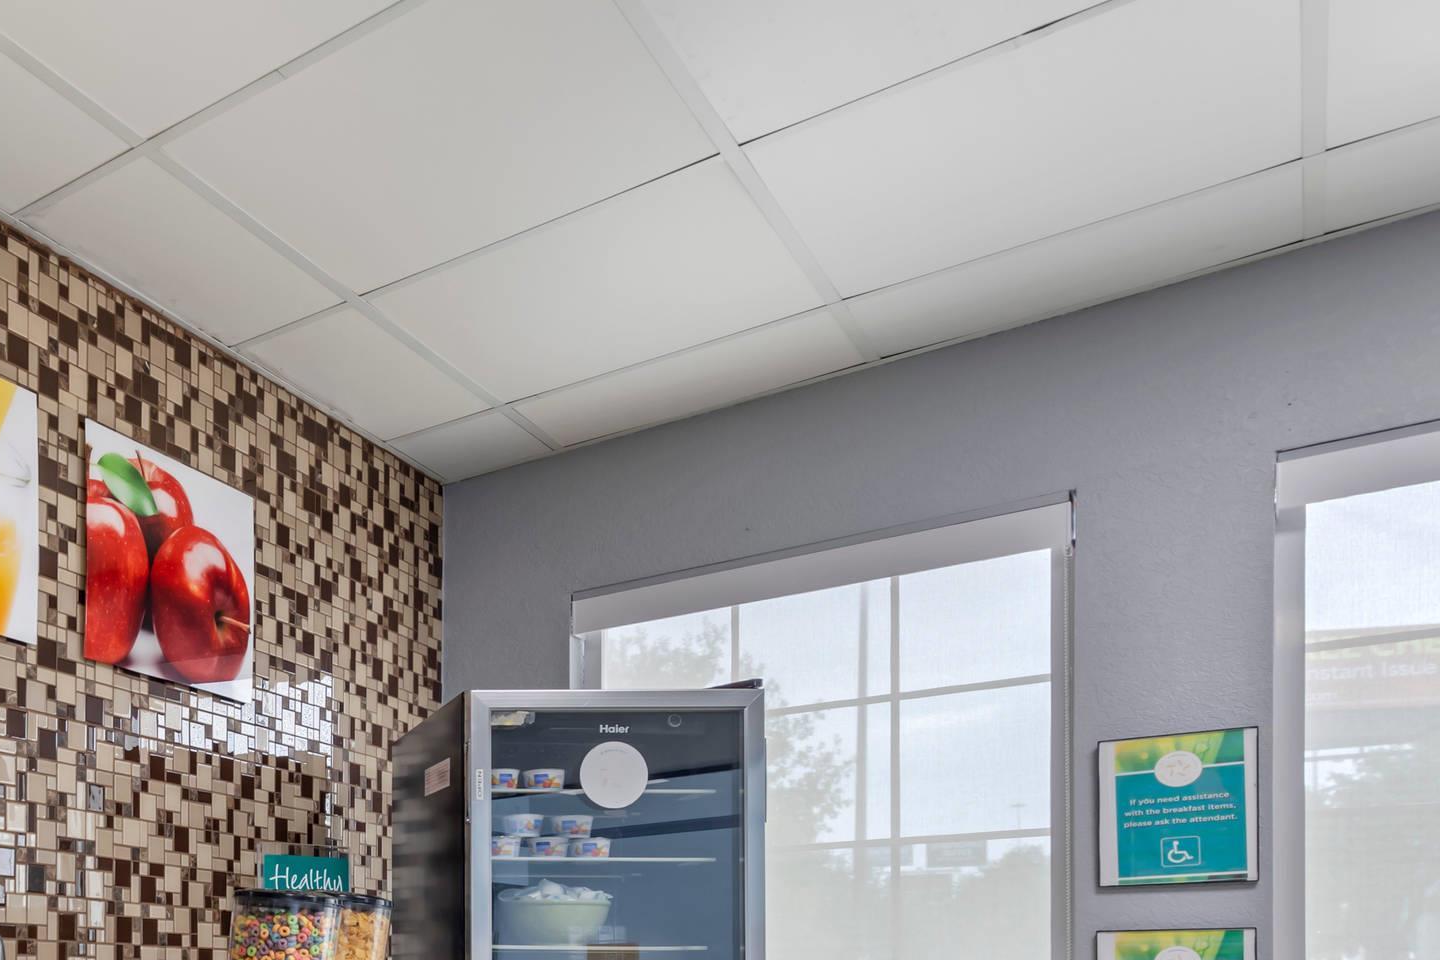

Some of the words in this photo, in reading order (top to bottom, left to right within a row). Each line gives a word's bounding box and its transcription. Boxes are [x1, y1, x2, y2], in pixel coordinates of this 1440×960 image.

[599, 724, 630, 734] Haier
[1138, 798, 1155, 806] you
[1157, 795, 1180, 803] need
[1182, 792, 1230, 802] assistance
[1124, 809, 1144, 817] with
[1145, 808, 1160, 816] the
[1162, 804, 1205, 814] breakfast
[1123, 820, 1153, 830] please
[1154, 818, 1170, 826] ask
[1172, 817, 1188, 825] the
[1189, 813, 1238, 824] attendant.
[269, 863, 343, 892] Healthy
